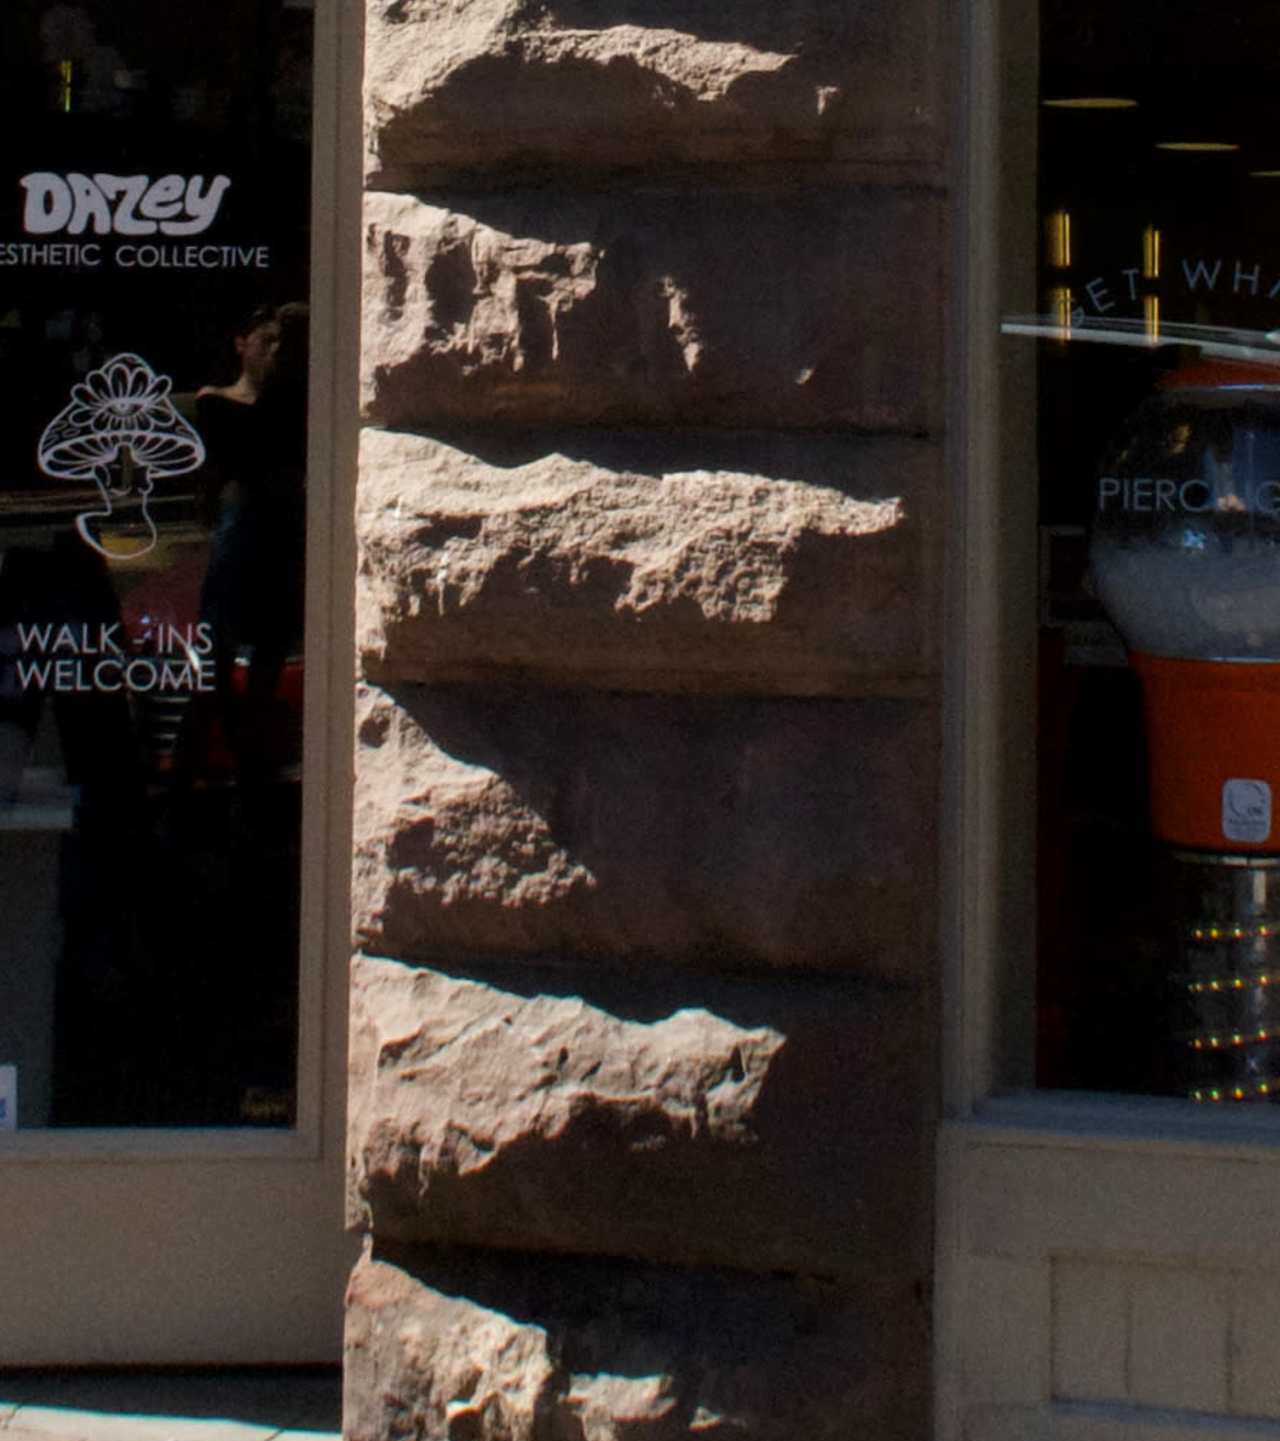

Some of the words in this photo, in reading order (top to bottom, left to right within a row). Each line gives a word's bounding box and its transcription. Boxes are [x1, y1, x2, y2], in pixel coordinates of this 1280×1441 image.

[113, 244, 270, 270] COLLECTIVE
[16, 621, 122, 656] WALK
[156, 622, 213, 656] INS
[16, 659, 218, 692] WELCOME
